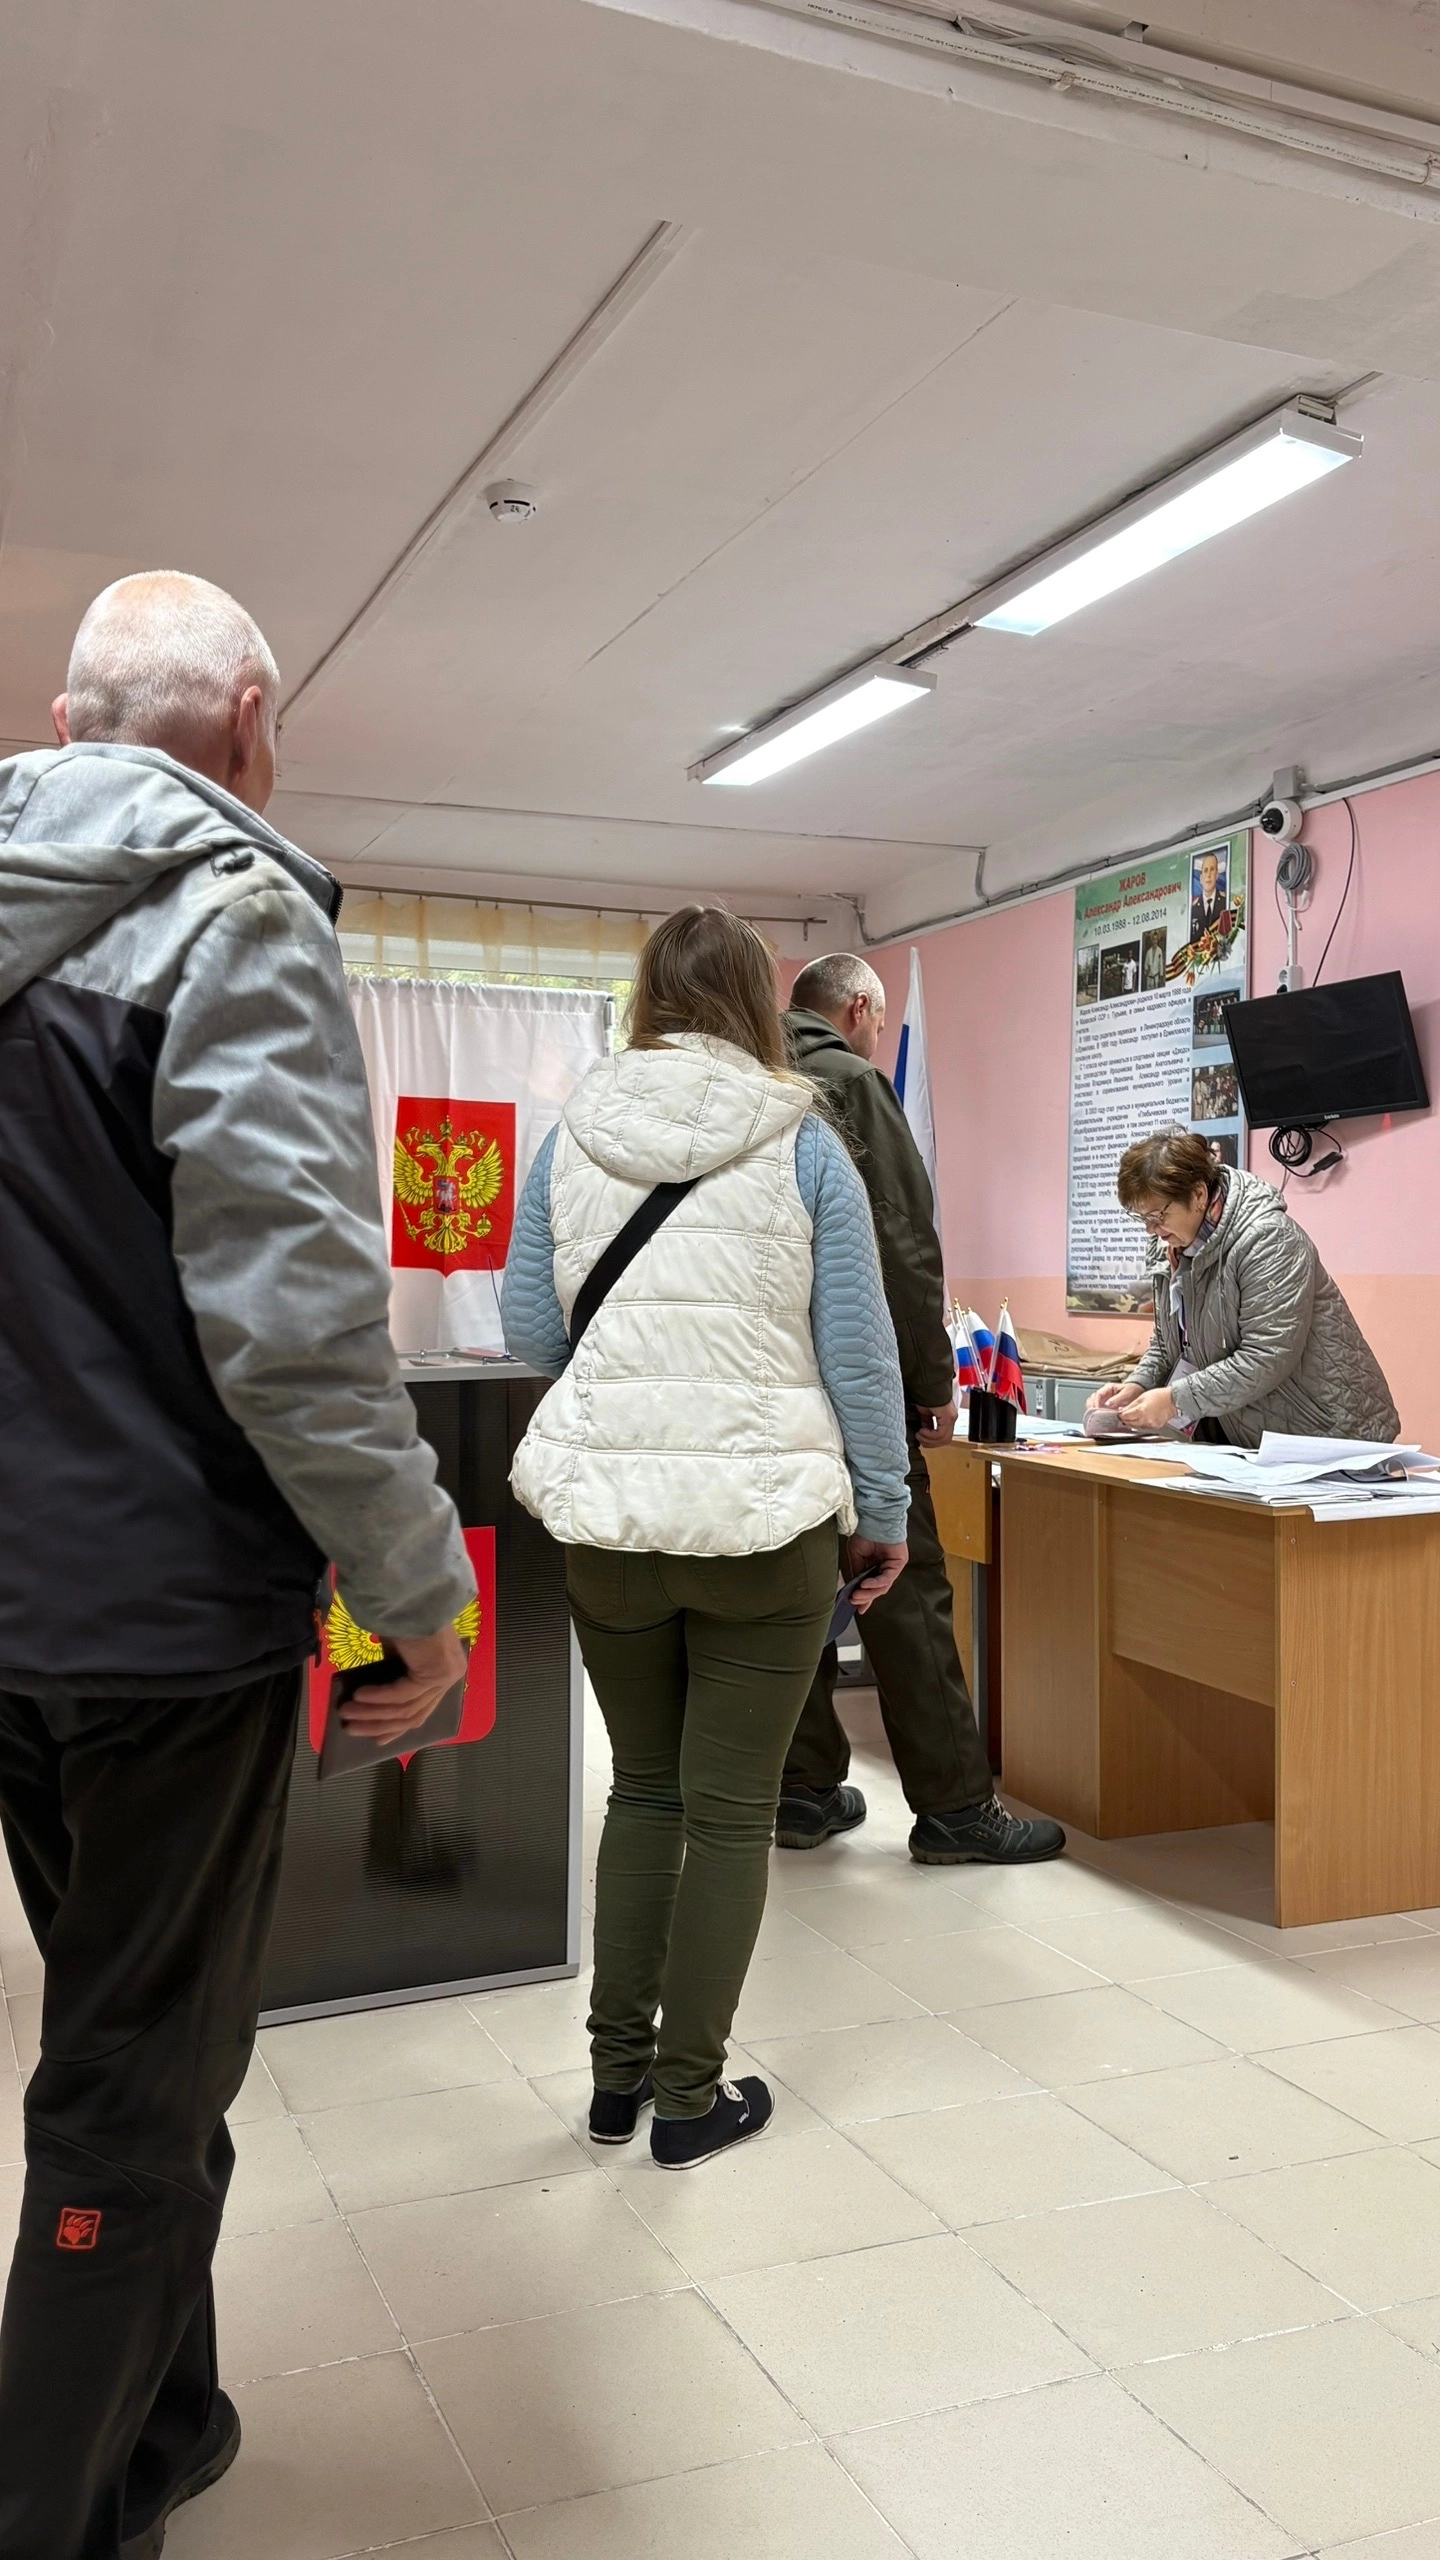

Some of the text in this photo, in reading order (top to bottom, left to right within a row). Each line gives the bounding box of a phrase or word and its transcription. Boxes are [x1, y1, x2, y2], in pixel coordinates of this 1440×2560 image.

[1119, 872, 1146, 892] ЖАРОВ
[1084, 881, 1181, 919] Александр Александрович
